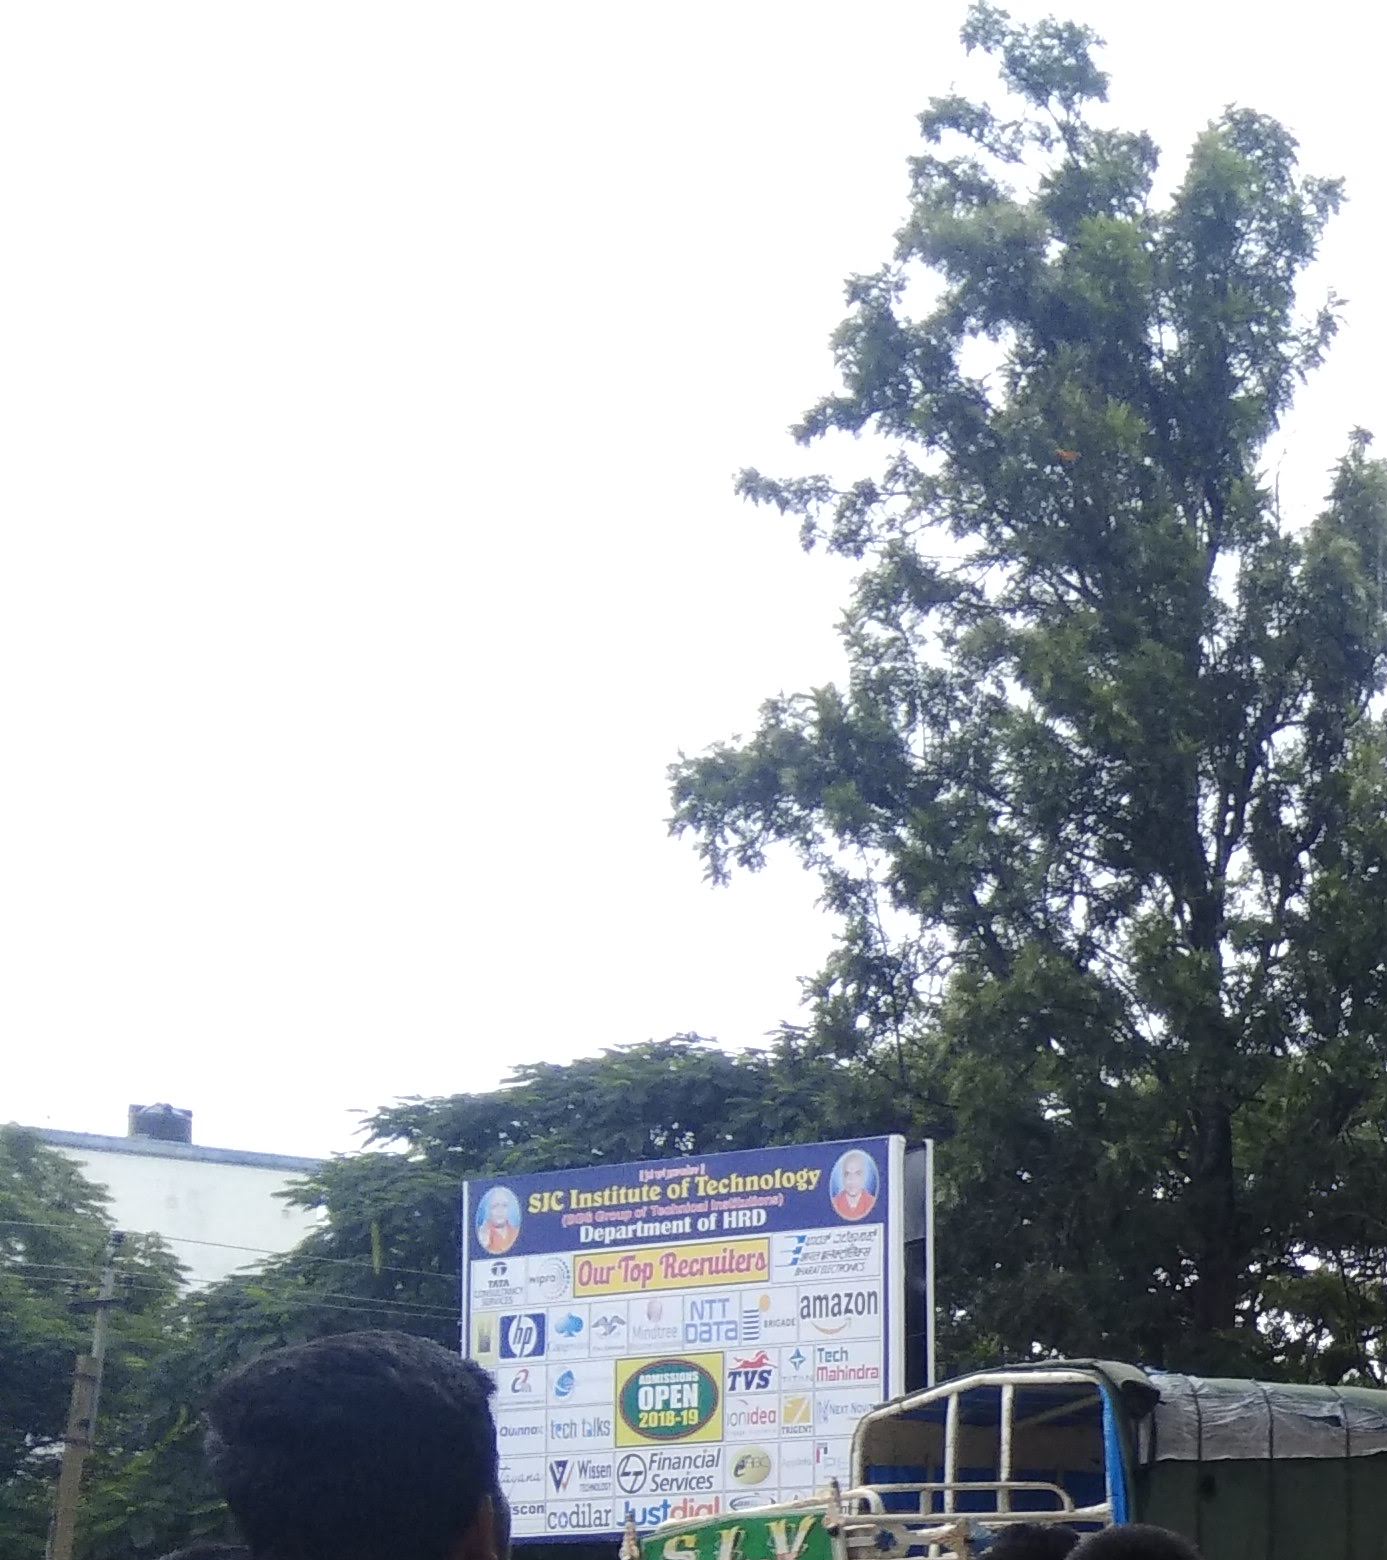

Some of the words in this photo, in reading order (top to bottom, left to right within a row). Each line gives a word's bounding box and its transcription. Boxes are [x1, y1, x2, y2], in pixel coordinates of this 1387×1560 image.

[528, 1191, 565, 1214] SJC
[569, 1183, 662, 1210] Institute
[667, 1176, 690, 1200] of
[694, 1167, 822, 1197] Technology
[594, 1209, 633, 1223] Group
[634, 1206, 648, 1218] of
[650, 1200, 709, 1217] Technical
[579, 1216, 692, 1245] Department
[697, 1211, 718, 1230] of
[723, 1208, 768, 1230] HRD
[578, 1259, 616, 1287] Our
[617, 1255, 654, 1288] Top
[659, 1248, 768, 1279] Recruiters
[488, 1279, 510, 1289] TATA
[529, 1274, 556, 1287] wipro
[690, 1298, 730, 1321] NTT
[800, 1289, 879, 1320] amazon
[632, 1325, 678, 1340] Mindtree
[763, 1317, 796, 1329] BRIGADE
[817, 1347, 849, 1363] Tech
[638, 1370, 699, 1386] ADMISSIONS
[727, 1369, 773, 1391] TVS
[816, 1364, 879, 1382] Mahindra
[638, 1382, 699, 1411] OPEN
[638, 1409, 699, 1428] 2018-19
[726, 1407, 776, 1427] ionidea
[781, 1425, 813, 1434] TRIGENT
[649, 1447, 721, 1471] Financial
[578, 1460, 612, 1480] Wissen
[579, 1482, 611, 1492] TECHNOLOGY
[650, 1472, 713, 1493] Services
[547, 1503, 612, 1530] codilar
[616, 1496, 720, 1528] Justdial
